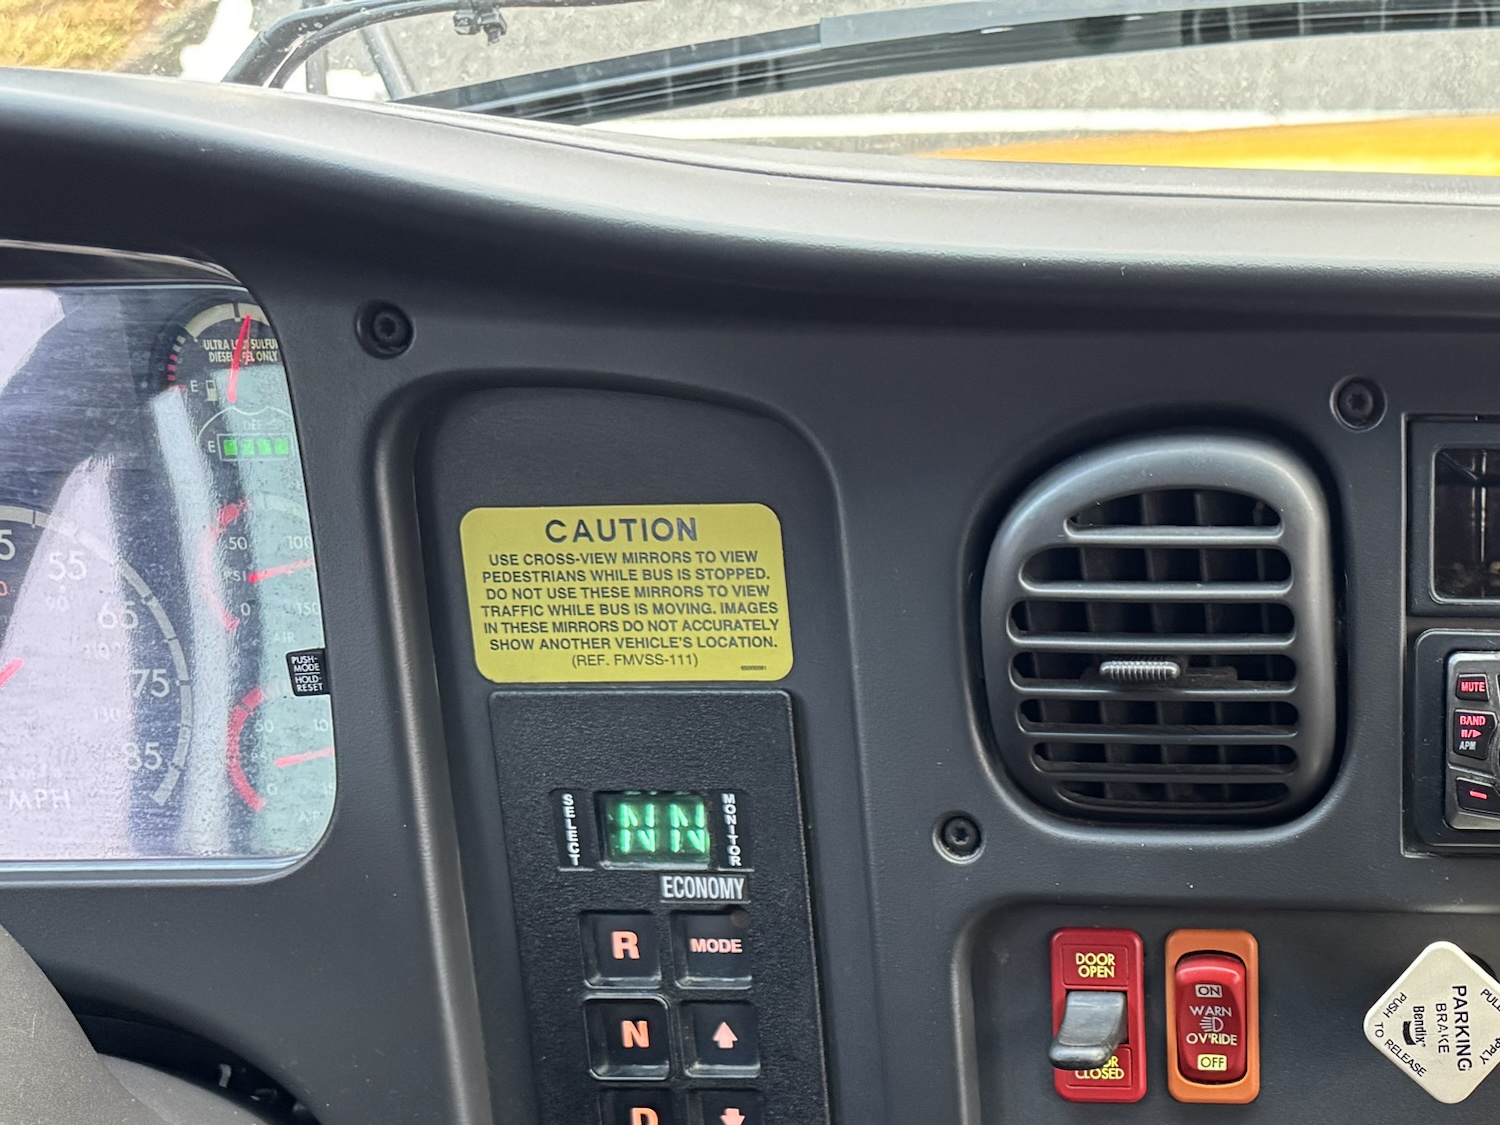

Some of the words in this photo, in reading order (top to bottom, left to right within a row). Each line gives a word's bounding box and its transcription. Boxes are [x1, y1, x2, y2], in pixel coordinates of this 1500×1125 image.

[203, 339, 229, 350] ULTRA
[256, 351, 278, 362] ONLY
[190, 380, 198, 392] E
[545, 518, 698, 543] CAUTION
[229, 537, 247, 550] 50
[49, 550, 86, 581] 55
[489, 554, 519, 566] USE
[523, 552, 617, 566] CROSS-VIEW
[622, 552, 692, 564] MIRRORS
[695, 551, 716, 563] TO
[719, 551, 758, 563] VIEW
[483, 570, 586, 583] PEDESTRIANS
[590, 569, 637, 582] WHILE
[642, 569, 673, 581] BUS
[678, 568, 691, 580] IS
[696, 568, 770, 580] STOPPED.
[487, 588, 508, 600] DO
[512, 587, 542, 600] NOT
[547, 587, 577, 599] USE
[580, 587, 630, 599] THESE
[634, 586, 704, 598] MIRRORS
[708, 586, 728, 597] TO
[732, 585, 770, 597] VIEW
[98, 599, 139, 629] 65
[481, 604, 543, 617] TRAFFIC
[547, 604, 595, 617] WHILE
[600, 604, 630, 616] BUS
[635, 603, 648, 615] IS
[652, 602, 717, 615] MOVING.
[720, 602, 778, 614] IMAGES
[484, 622, 498, 634] IN
[501, 621, 549, 634] THESE
[553, 620, 619, 633] MIRRORS
[623, 620, 644, 632] DO
[648, 620, 678, 632] NOT
[682, 619, 779, 631] ACCURATELY
[490, 638, 534, 651] SHOW
[539, 638, 611, 650] ANOTHER
[616, 637, 693, 650] VEHICLE'S
[697, 636, 778, 649] LOCATION.
[291, 656, 318, 664] PUSH-
[294, 663, 320, 672] MODE
[572, 655, 610, 668] (REF.
[614, 653, 698, 667] FMVSS-111)
[132, 668, 170, 698] 75
[295, 676, 322, 684] HOLD-
[297, 683, 323, 692] RESET
[1460, 681, 1485, 693] MUTE
[1460, 715, 1486, 727] BAND
[124, 741, 162, 771] 85
[9, 789, 71, 809] MPH
[561, 793, 581, 866] SELECT
[619, 803, 707, 853] NN
[721, 793, 742, 867] MONITOR
[662, 875, 745, 900] ECONOMY
[611, 931, 640, 959] R
[689, 938, 743, 953] MODE
[1076, 953, 1116, 966] DOOR
[1078, 966, 1115, 978] OPEN
[1198, 986, 1220, 996] ON
[1189, 1006, 1232, 1017] WARN
[1382, 992, 1407, 1019] PUSH
[621, 1020, 650, 1048] N
[1374, 1022, 1384, 1038] TO
[1436, 1003, 1450, 1053] BRAKE
[1452, 985, 1472, 1072] PARKING
[1186, 1032, 1237, 1046] OV'RIDE
[1200, 1057, 1224, 1068] OFF
[1384, 1039, 1427, 1077] RELEASE
[1075, 1067, 1125, 1080] CLOSED
